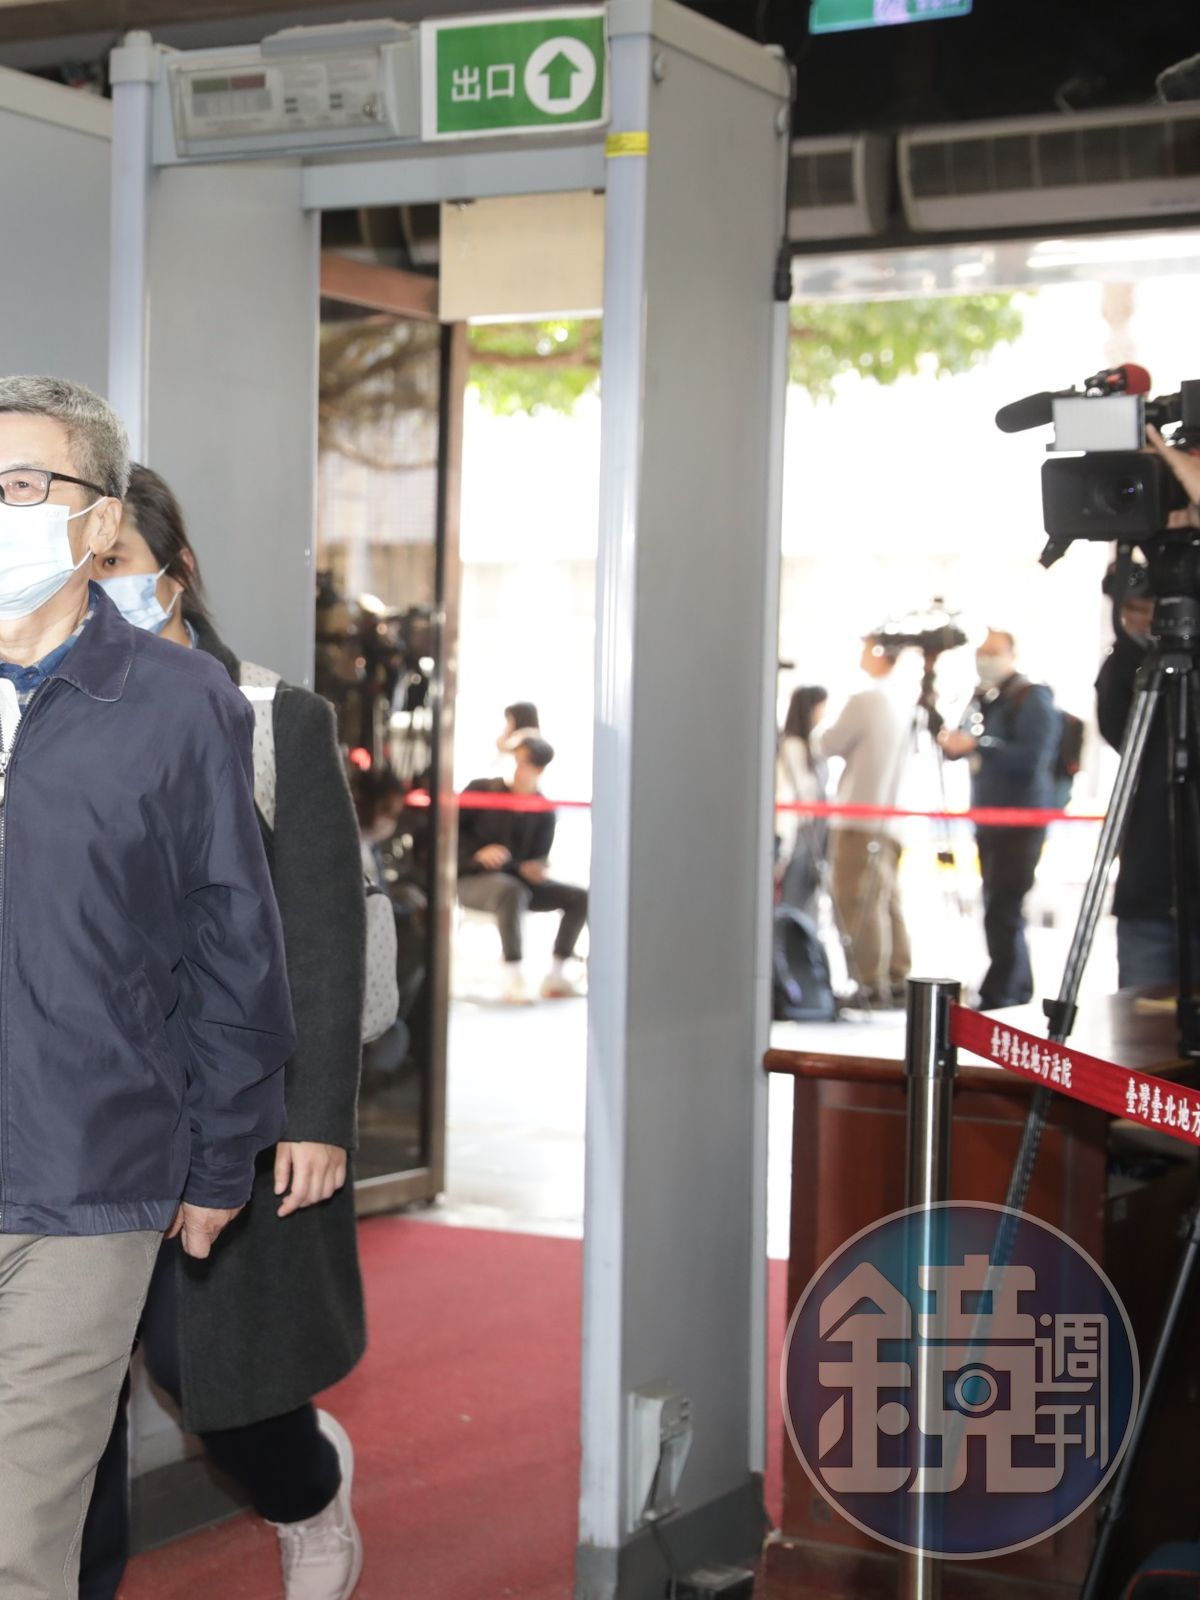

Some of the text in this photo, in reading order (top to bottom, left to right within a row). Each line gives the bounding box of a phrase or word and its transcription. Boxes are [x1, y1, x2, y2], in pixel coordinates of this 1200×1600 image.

[451, 63, 516, 102] 出口
[990, 1025, 1073, 1089] 臺灣臺北地方法院
